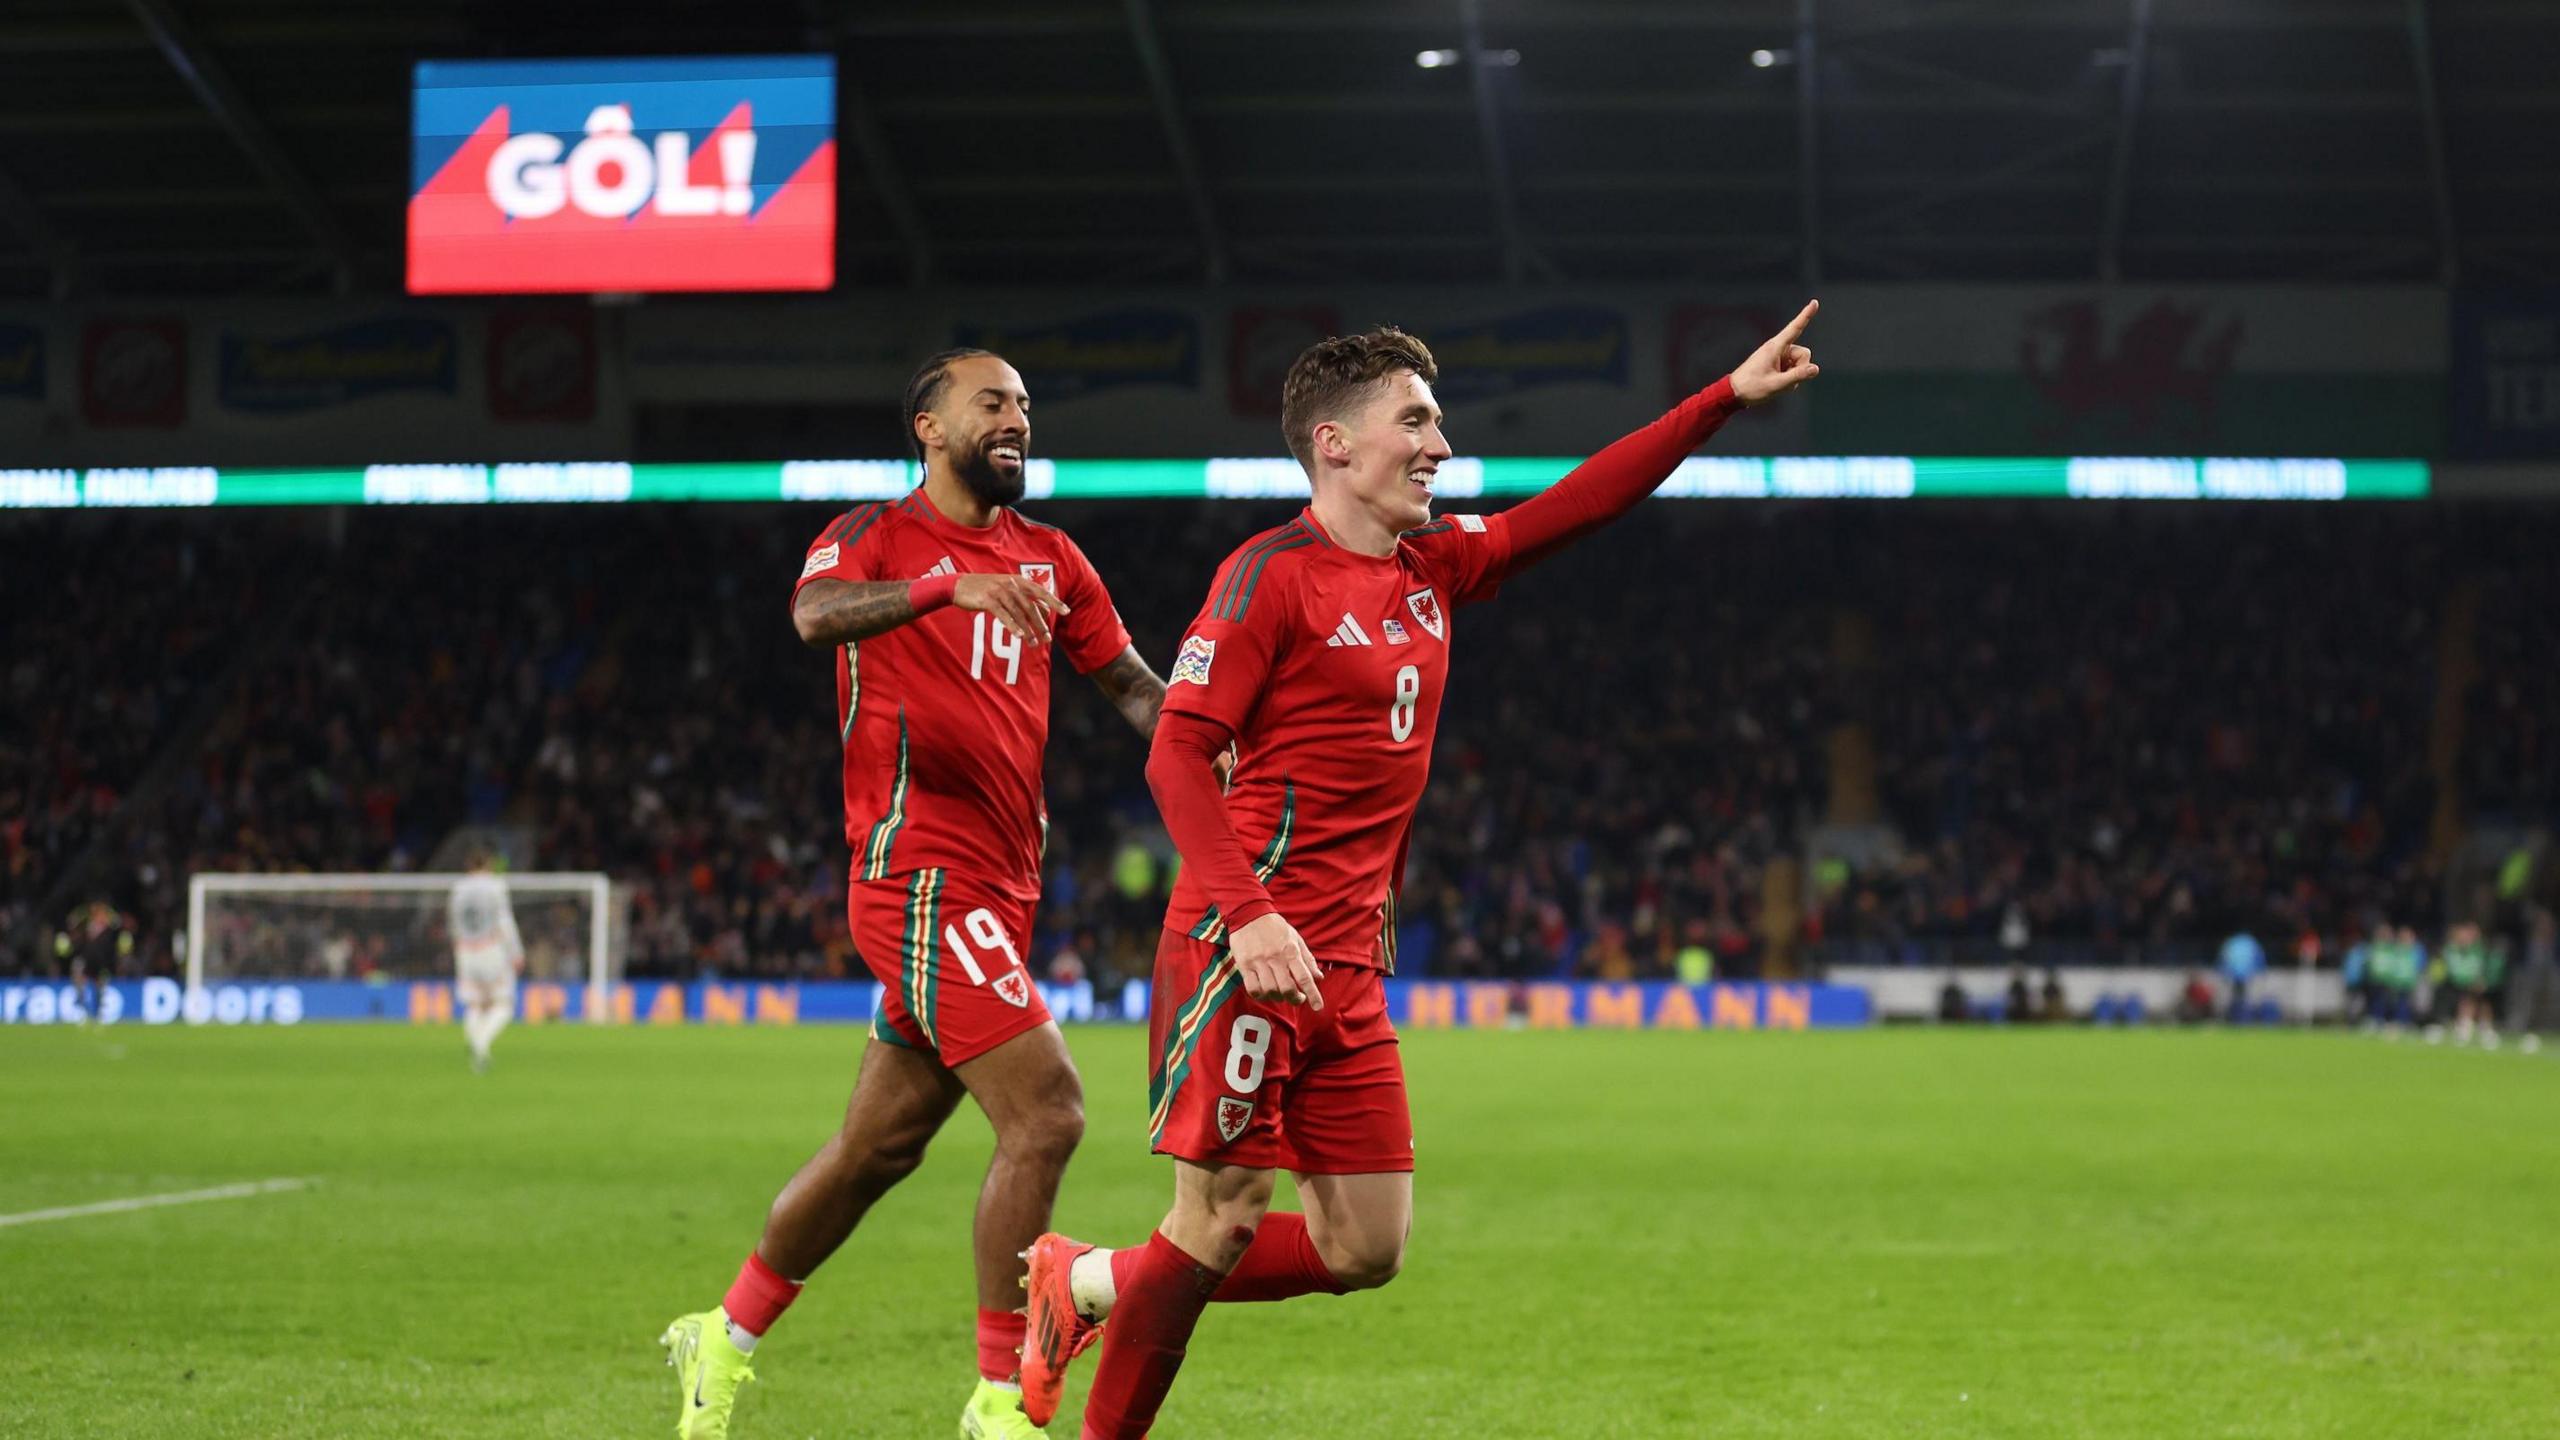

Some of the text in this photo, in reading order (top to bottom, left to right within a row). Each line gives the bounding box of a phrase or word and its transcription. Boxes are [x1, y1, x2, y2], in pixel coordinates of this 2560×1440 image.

[486, 104, 757, 218] GÔL!
[1389, 664, 1420, 744] 8
[944, 907, 1021, 987] 19
[407, 981, 801, 1026] HRMANN
[1224, 1014, 1272, 1094] 8
